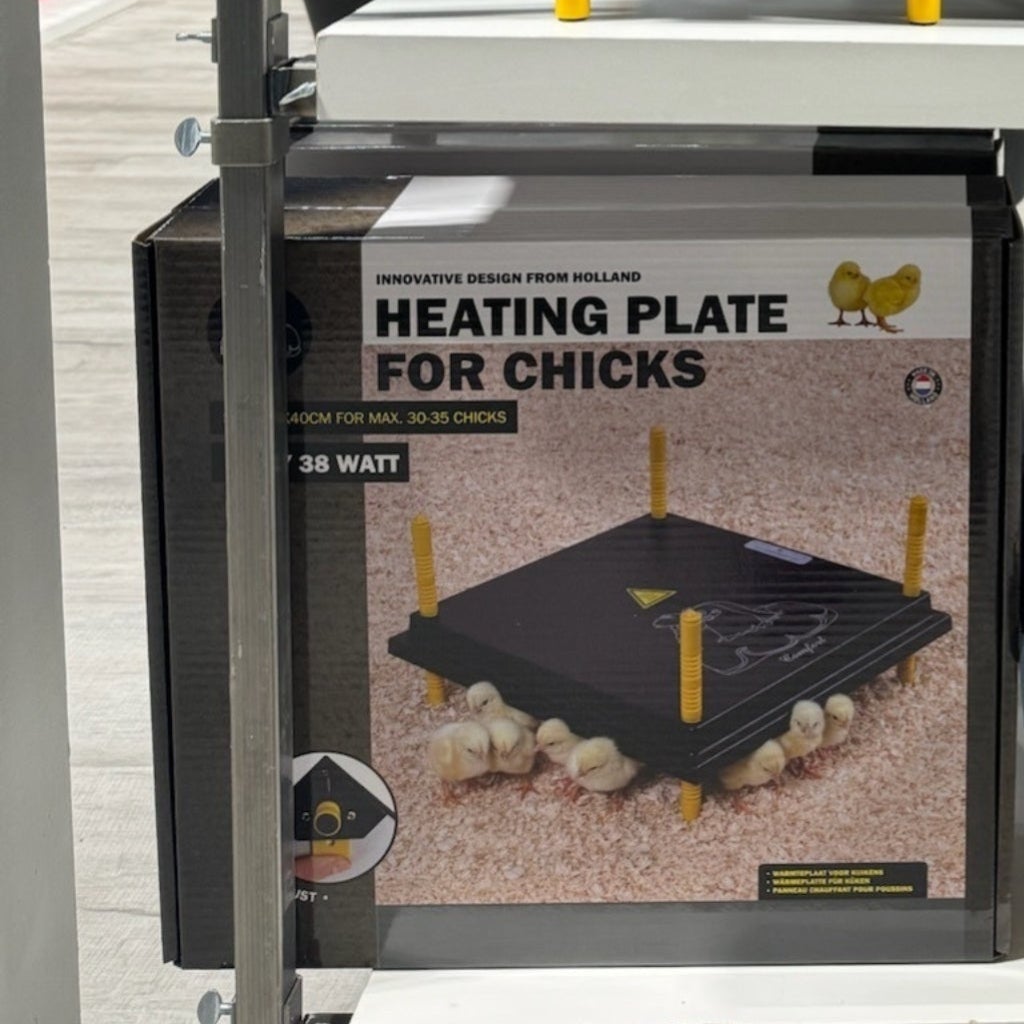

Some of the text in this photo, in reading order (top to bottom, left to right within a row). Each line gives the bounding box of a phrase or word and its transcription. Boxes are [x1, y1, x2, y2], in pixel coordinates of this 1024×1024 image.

[375, 271, 642, 286] INNOVATIVE DESIGN FROM HOLLAND
[376, 294, 788, 337] HEATING PLATE
[376, 349, 706, 392] FOR CHICKS
[336, 412, 364, 425] FOR
[368, 412, 403, 425] MAX.
[406, 411, 449, 425] 30-35
[453, 411, 507, 424] CHICKS
[298, 454, 330, 474] 38
[336, 454, 400, 474] WATT
